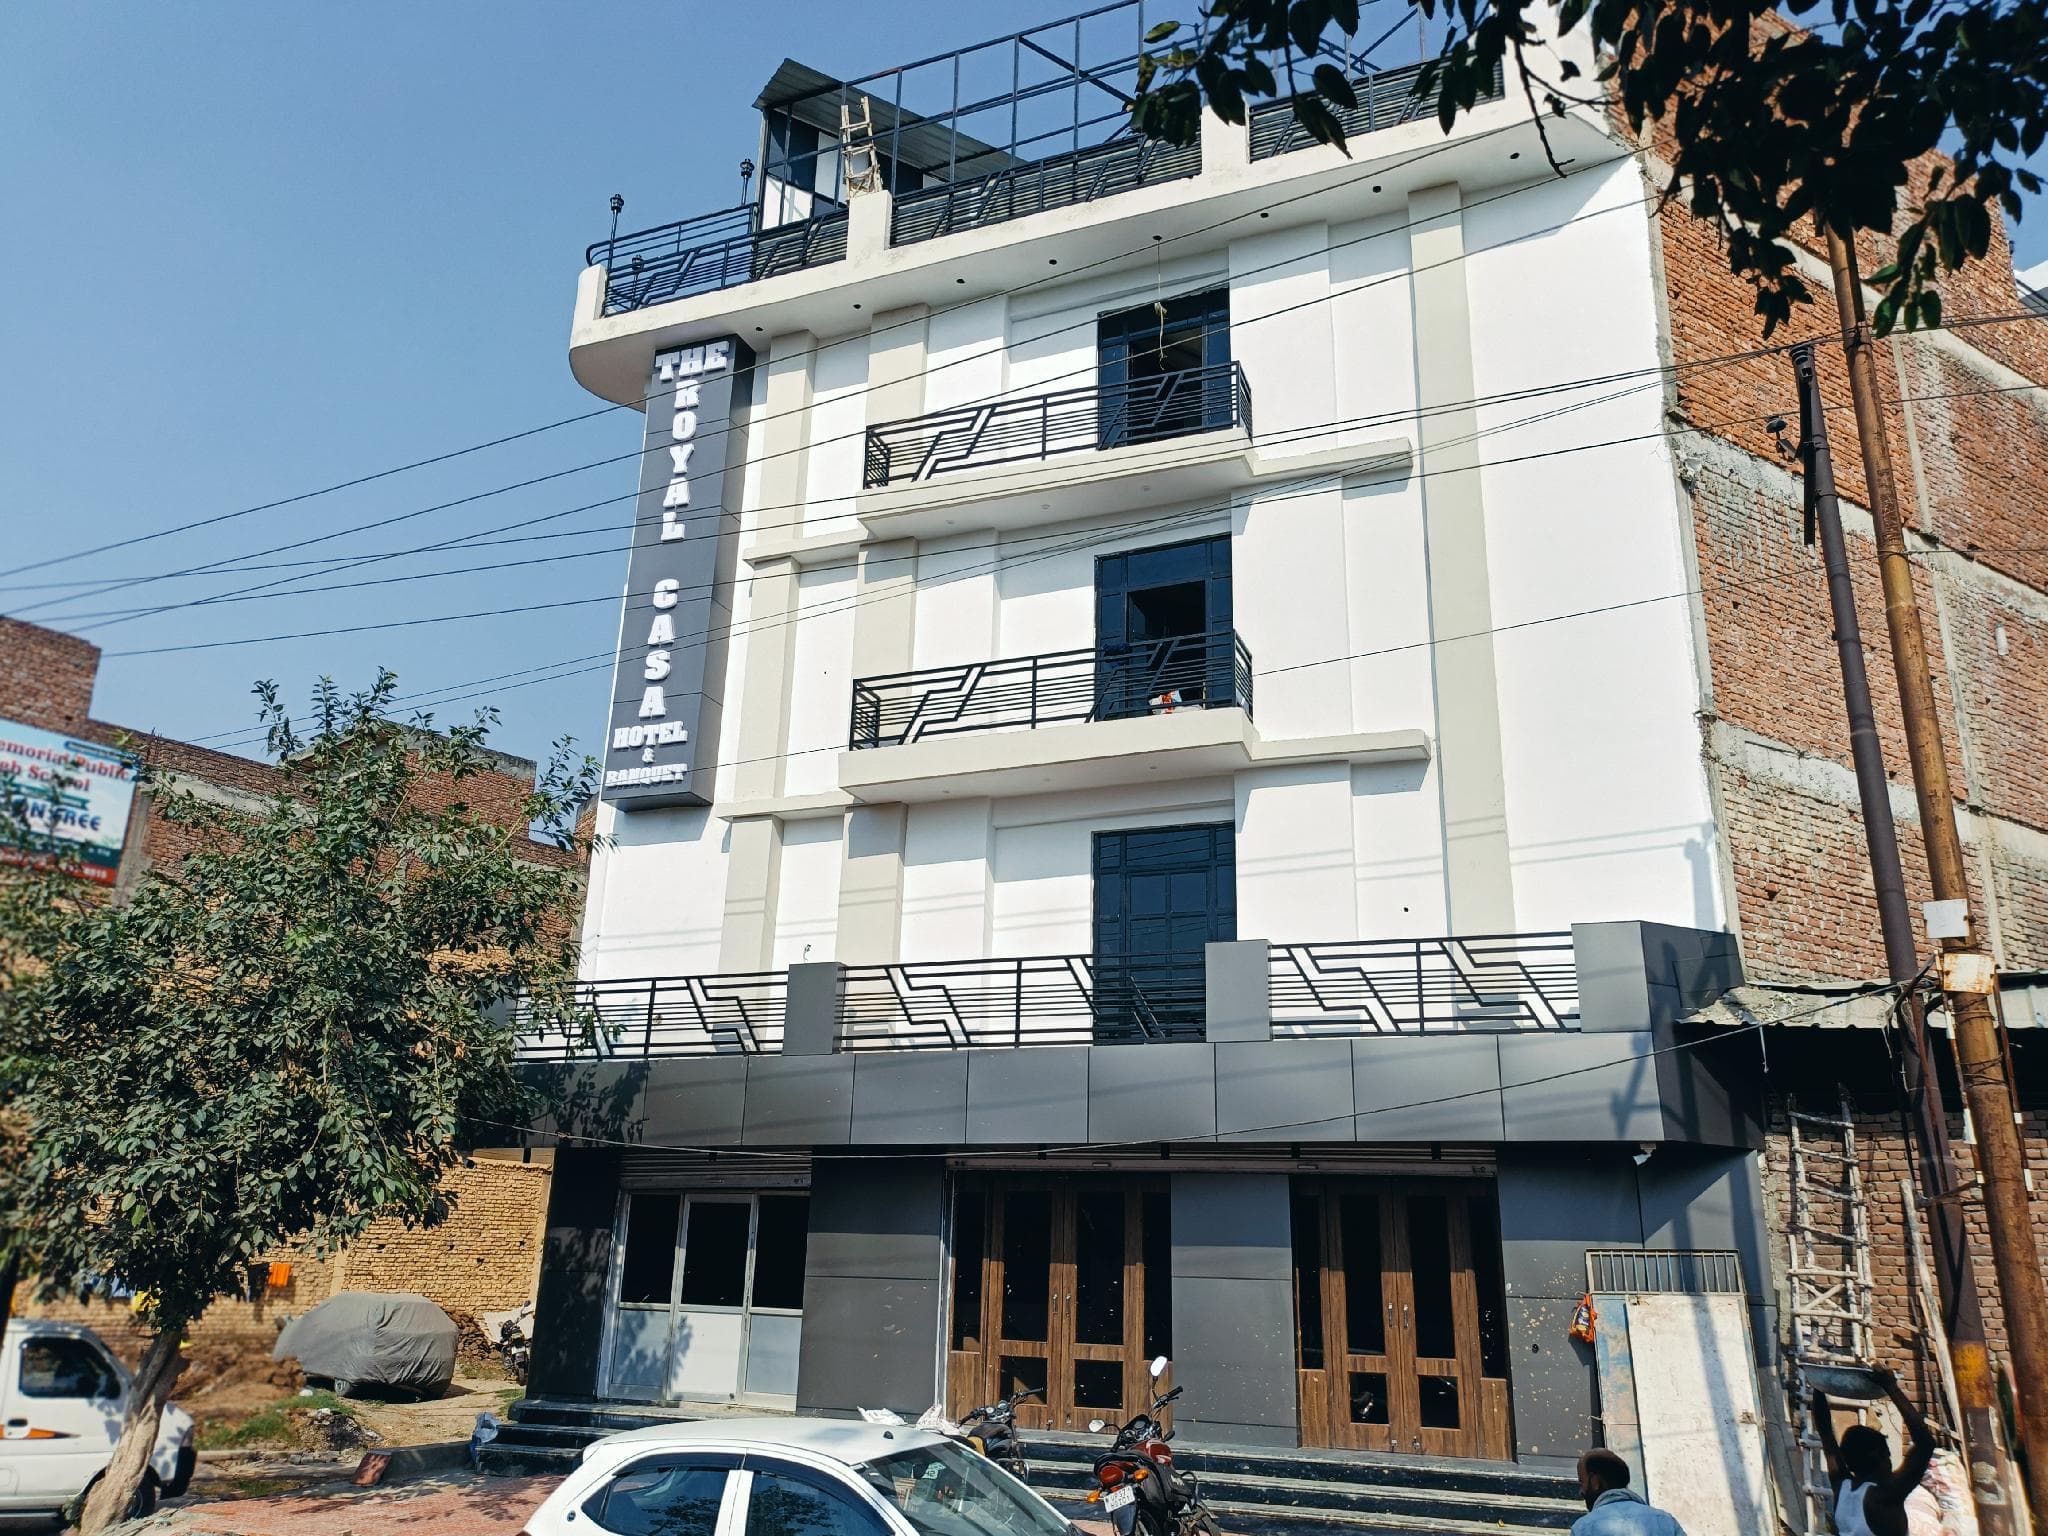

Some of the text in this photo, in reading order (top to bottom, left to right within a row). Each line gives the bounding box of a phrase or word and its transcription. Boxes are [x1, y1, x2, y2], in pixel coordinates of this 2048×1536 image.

[655, 341, 729, 381] THE
[639, 380, 699, 718] ROYAL CASA
[612, 720, 688, 749] HOTEL
[641, 747, 655, 763] &
[28, 763, 90, 791] Scol
[604, 763, 688, 787] BANQUET
